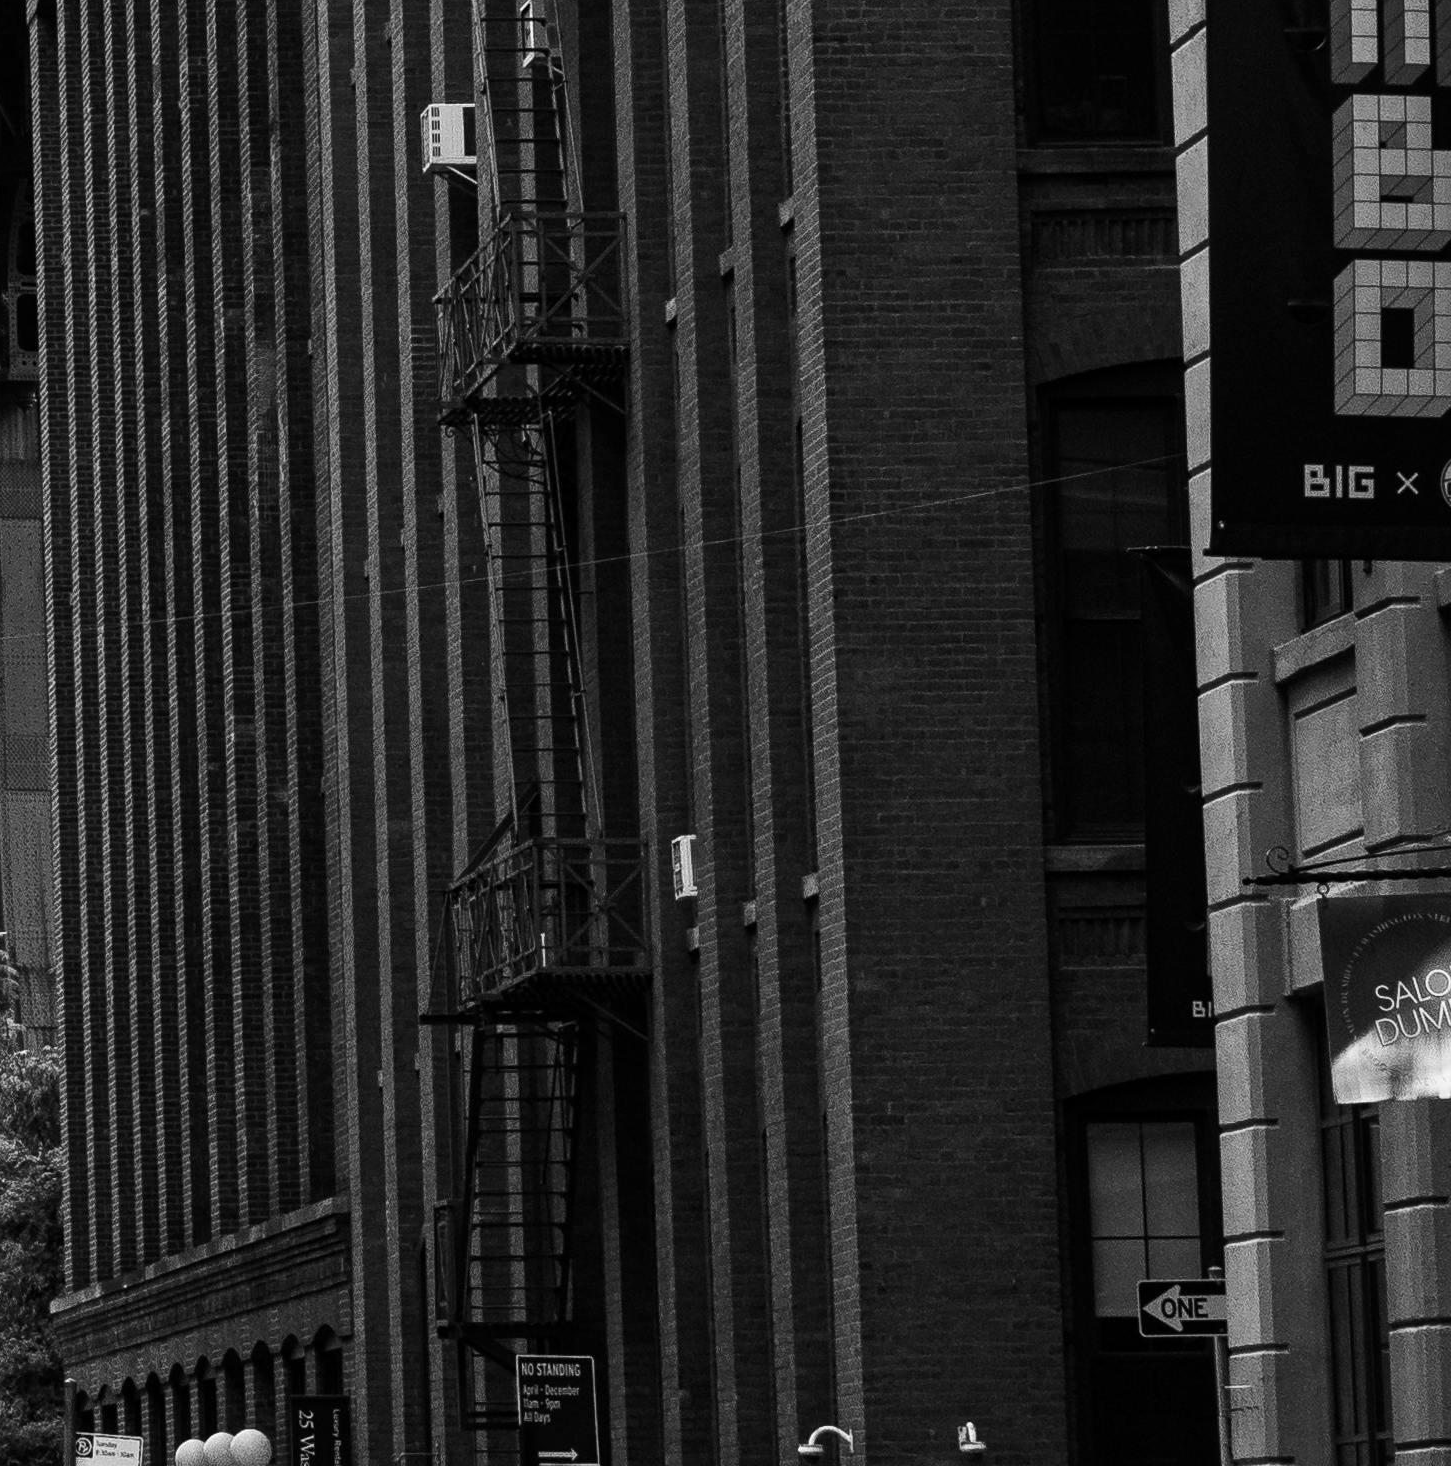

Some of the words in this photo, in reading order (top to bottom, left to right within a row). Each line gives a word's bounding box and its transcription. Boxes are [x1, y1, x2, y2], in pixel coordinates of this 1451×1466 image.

[1304, 464, 1375, 499] BIG
[1375, 967, 1451, 1012] SALO
[1192, 1000, 1212, 1018] BI
[1375, 1001, 1451, 1046] DUM
[1161, 1297, 1209, 1319] ONE
[521, 1362, 534, 1376] NO
[536, 1363, 581, 1377] STANDING
[522, 1383, 539, 1397] April
[544, 1384, 580, 1396] December
[299, 1409, 316, 1429] 25
